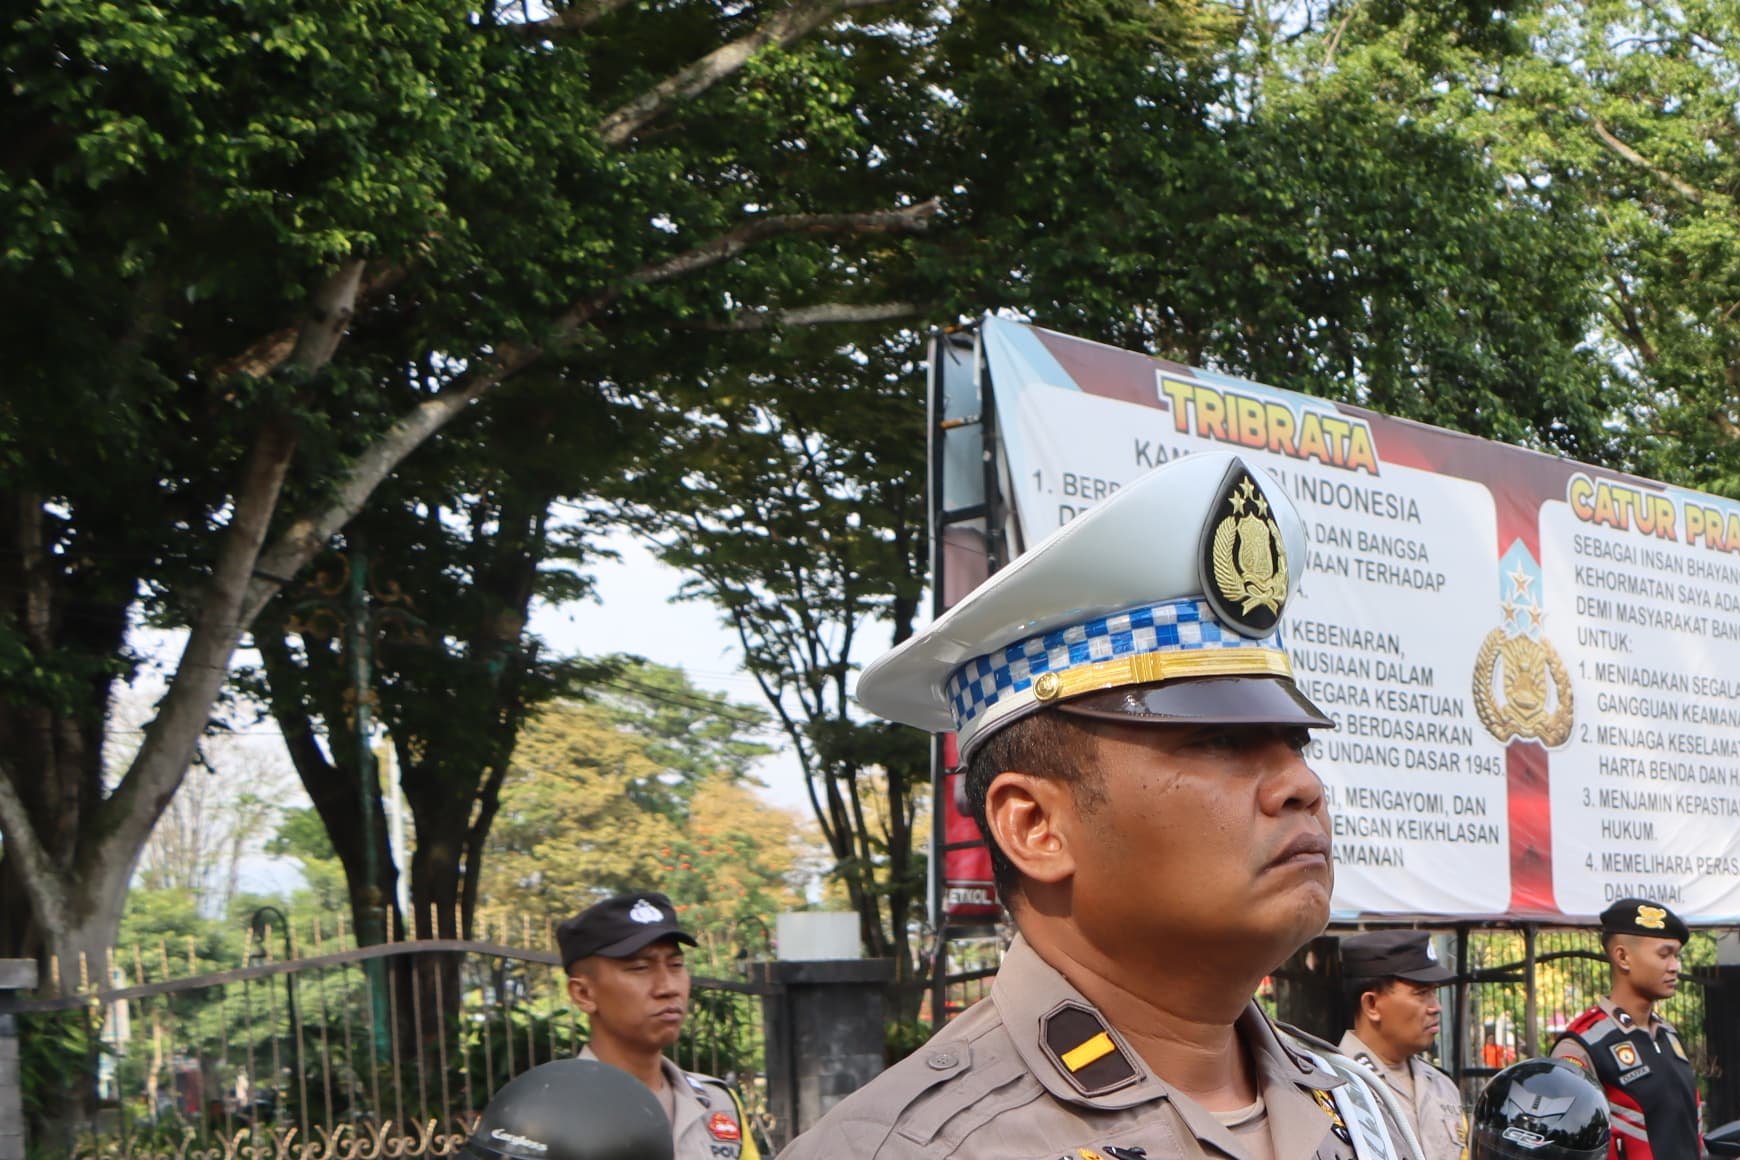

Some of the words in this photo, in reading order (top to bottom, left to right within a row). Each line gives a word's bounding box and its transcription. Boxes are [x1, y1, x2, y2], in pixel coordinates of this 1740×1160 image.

[1161, 377, 1380, 477] TRIBRATA
[1295, 474, 1422, 524] INDONESIA
[1570, 479, 1677, 542] CATUR
[1032, 469, 1053, 494] 1.
[1315, 522, 1351, 549] DAN
[1357, 530, 1430, 564] BANGSA
[1574, 534, 1637, 564] SEBAGAI
[1641, 547, 1683, 575] INSAN
[1354, 559, 1446, 593] TERHADAP
[1575, 565, 1674, 600] KEHORMATAN
[1678, 586, 1711, 608] SAYA
[1576, 595, 1612, 619] DEMI
[1616, 602, 1707, 636] MASYARAKAT
[1292, 618, 1405, 660] KEBENARAN,
[1375, 660, 1434, 687] DALAM
[1595, 661, 1689, 693] MENIADAKAN
[1301, 680, 1370, 708] NEGARA
[1375, 689, 1464, 718] KESATUAN
[1597, 692, 1679, 722] GANGGUAN
[1347, 713, 1473, 747] BERDASARKAN
[1596, 725, 1665, 752] MENJAGA
[1329, 741, 1400, 768] UNDANG
[1405, 749, 1460, 773] DASAR
[1465, 755, 1505, 777] 1945.
[1599, 755, 1646, 778] HARTA
[1649, 760, 1697, 784] BENDA
[1700, 765, 1727, 786] DAN
[1346, 786, 1449, 817] MENGAYOMI,
[1453, 795, 1486, 816] DAN
[1599, 788, 1673, 813] MENJAMIN
[1397, 820, 1499, 844] KEIKHLASAN
[1601, 819, 1658, 842] HUKUM.
[1602, 853, 1694, 876] MEMELIHARA
[1605, 883, 1634, 903] DAN
